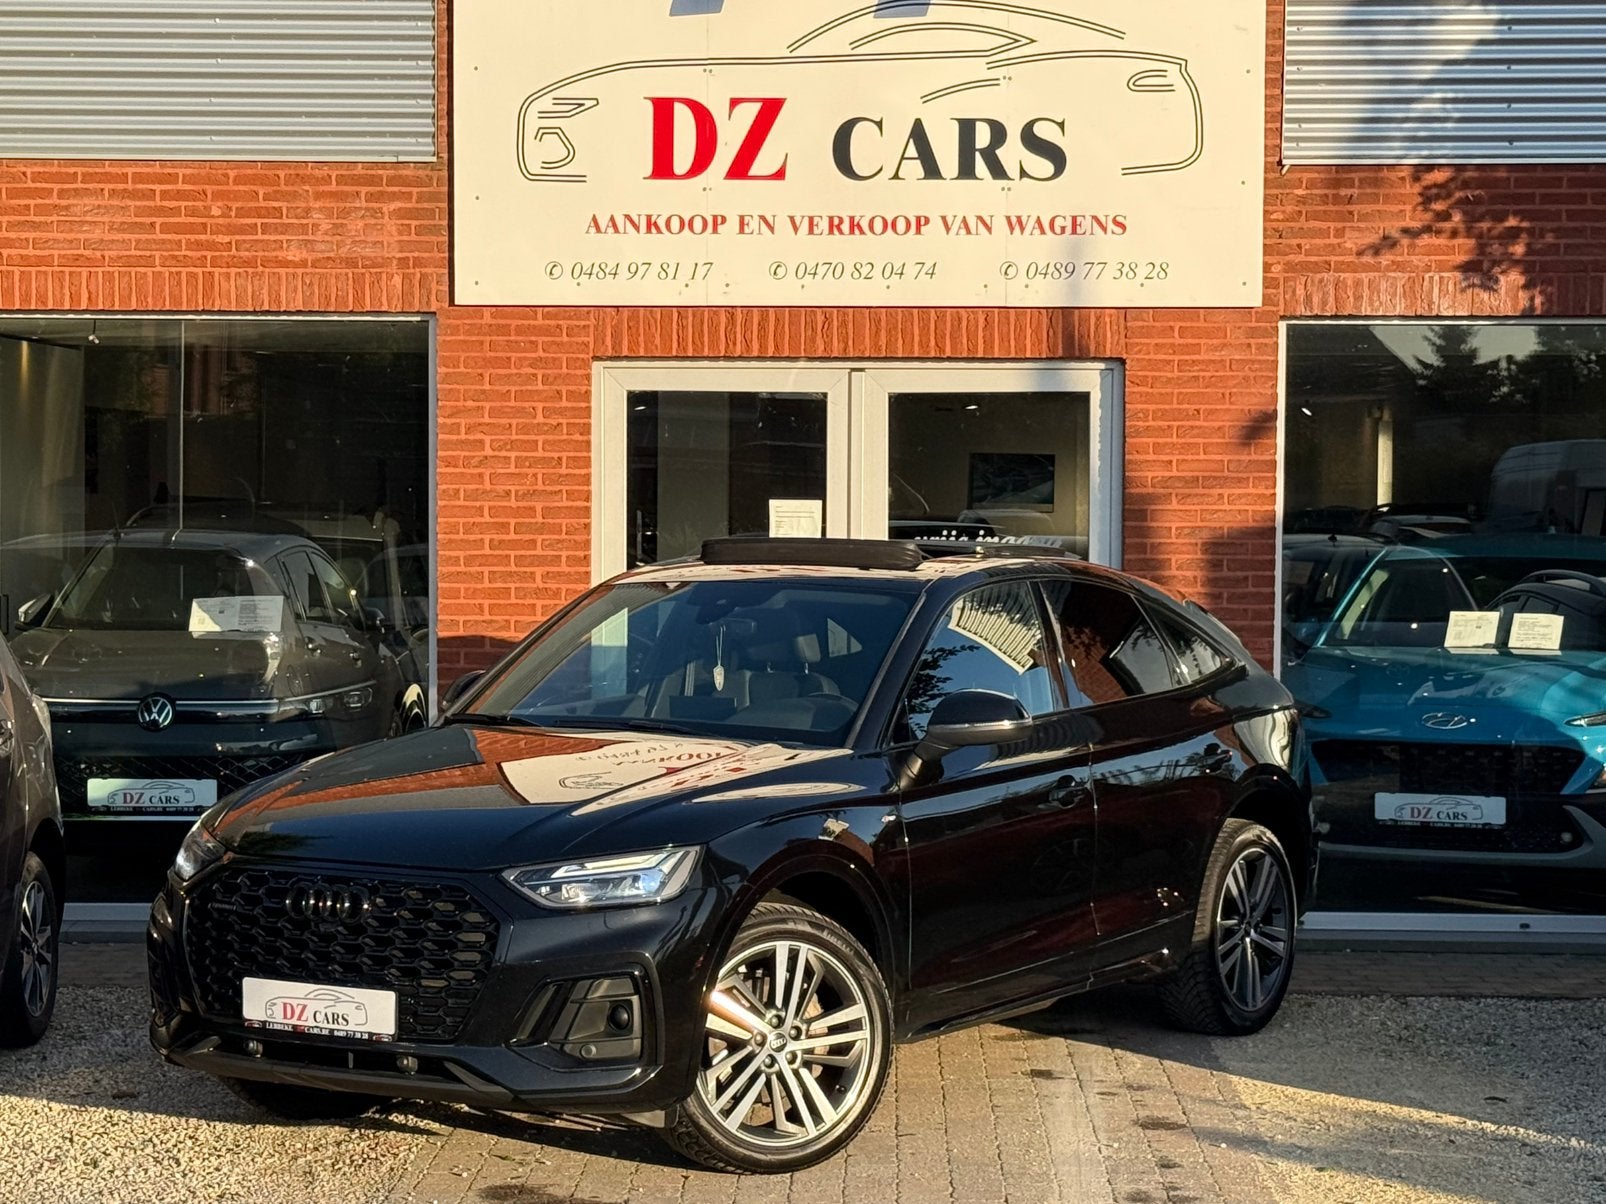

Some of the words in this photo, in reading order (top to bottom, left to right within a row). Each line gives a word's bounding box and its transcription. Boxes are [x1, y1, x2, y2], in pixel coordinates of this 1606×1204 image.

[643, 97, 788, 181] DZ
[832, 116, 1068, 182] CARS
[585, 213, 727, 235] AANKOOP
[736, 214, 777, 236] EN
[786, 214, 931, 236] VERKOOP
[938, 215, 995, 236] VAN
[1004, 214, 1128, 236] WAGENS
[570, 261, 620, 280] 0484
[627, 261, 652, 280] 97
[657, 261, 681, 280] 81
[688, 261, 714, 280] 17
[795, 261, 845, 281] 0470
[851, 261, 875, 281] 82
[881, 261, 906, 281] 04
[913, 261, 938, 281] 74
[1026, 261, 1076, 281] 0489
[1082, 261, 1108, 281] 77
[1113, 261, 1138, 281] 38
[1143, 261, 1170, 281] 28
[122, 792, 146, 805] DZ
[149, 795, 180, 805] CARS
[1410, 807, 1433, 819] DZ
[1436, 811, 1468, 821] CARS
[281, 1001, 309, 1022] DZ
[313, 1010, 350, 1027] CARS
